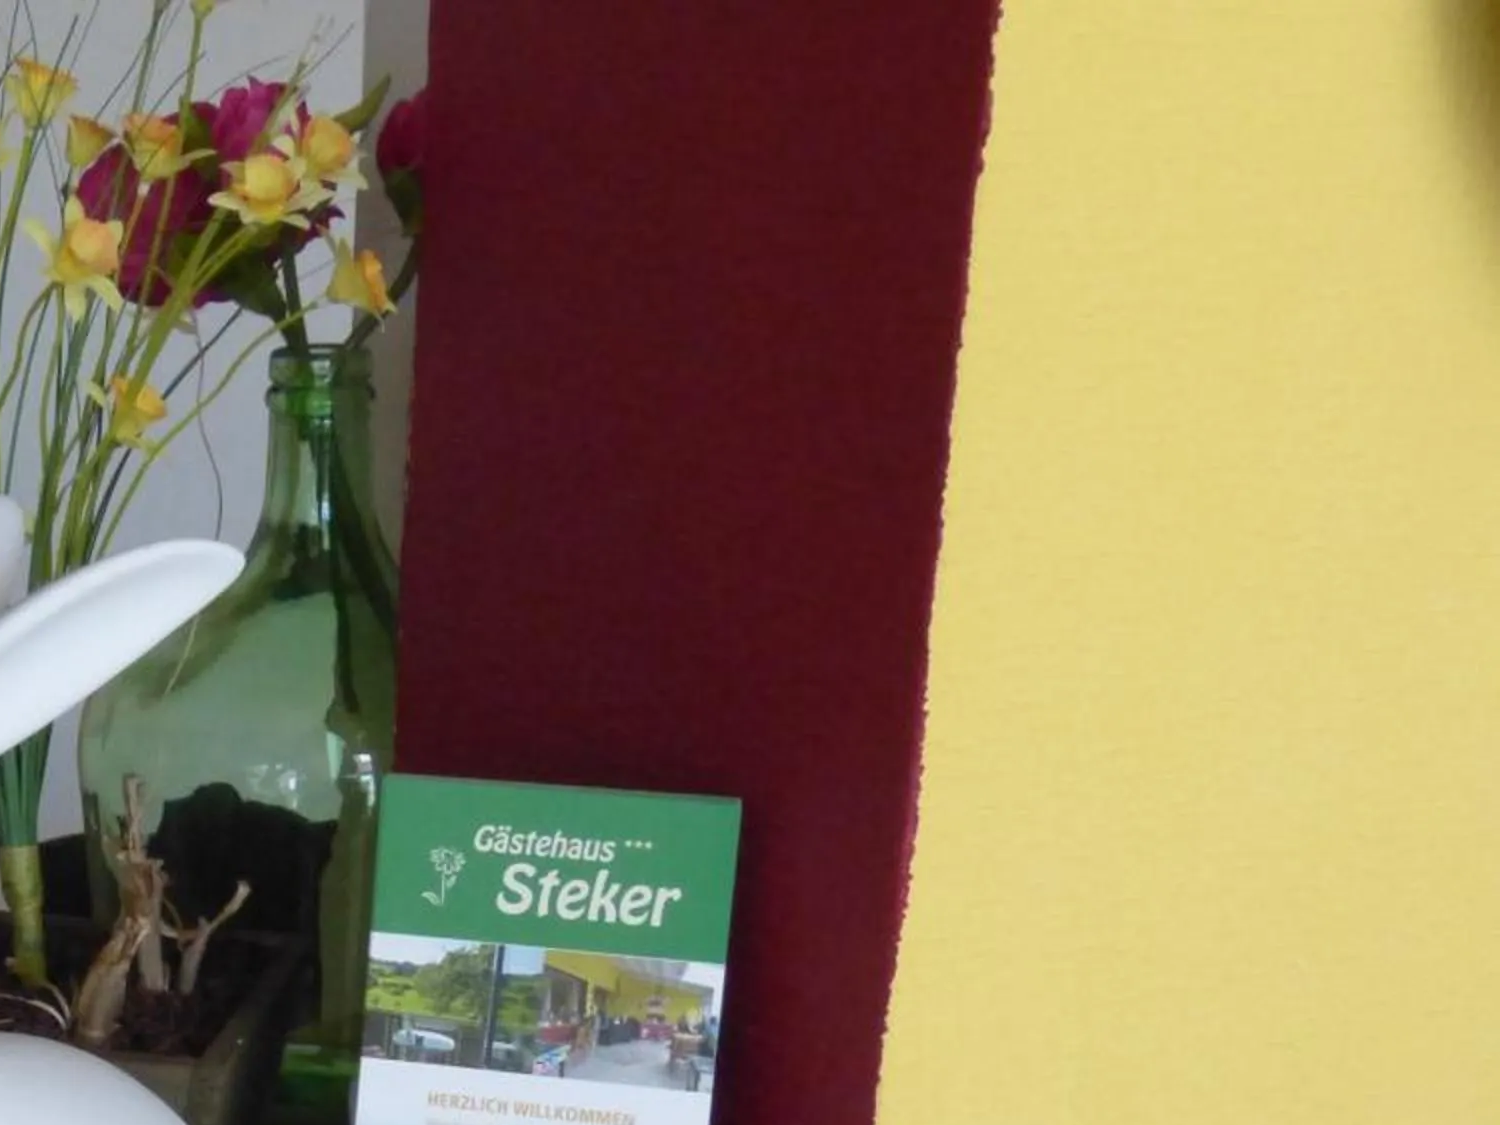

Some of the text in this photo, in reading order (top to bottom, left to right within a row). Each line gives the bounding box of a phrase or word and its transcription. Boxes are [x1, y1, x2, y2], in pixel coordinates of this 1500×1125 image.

[473, 824, 616, 863] Gästehaus
[495, 863, 682, 927] Steker
[427, 1090, 509, 1116] HERZLICH
